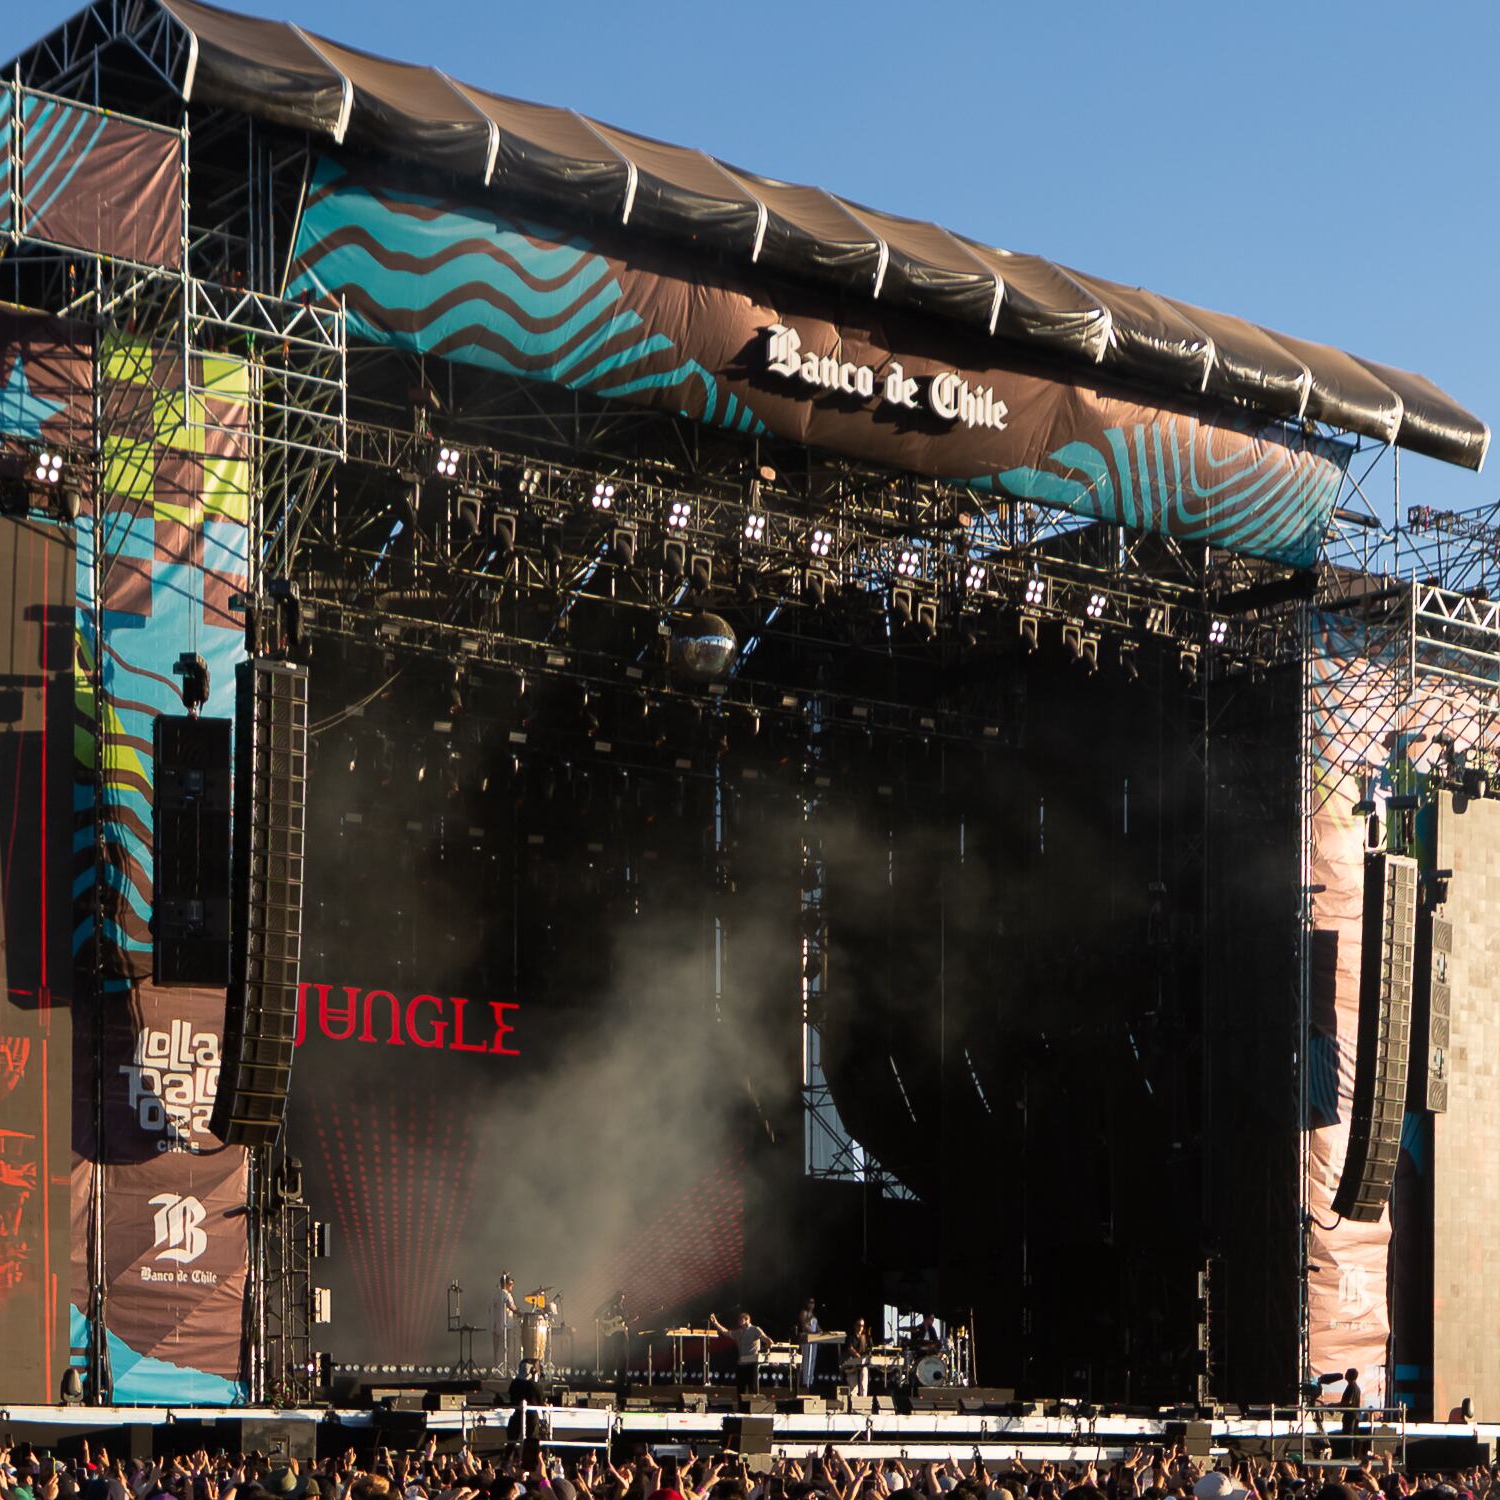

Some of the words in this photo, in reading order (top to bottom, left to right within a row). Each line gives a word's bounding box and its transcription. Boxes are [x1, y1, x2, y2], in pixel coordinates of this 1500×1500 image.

[767, 324, 874, 397] Banco
[885, 362, 920, 408] de
[930, 371, 1009, 431] Chile
[295, 982, 521, 1055] JUNGLE
[148, 1193, 207, 1263] B
[141, 1266, 174, 1282] Banco
[177, 1269, 188, 1282] de
[191, 1269, 218, 1284] Chile
